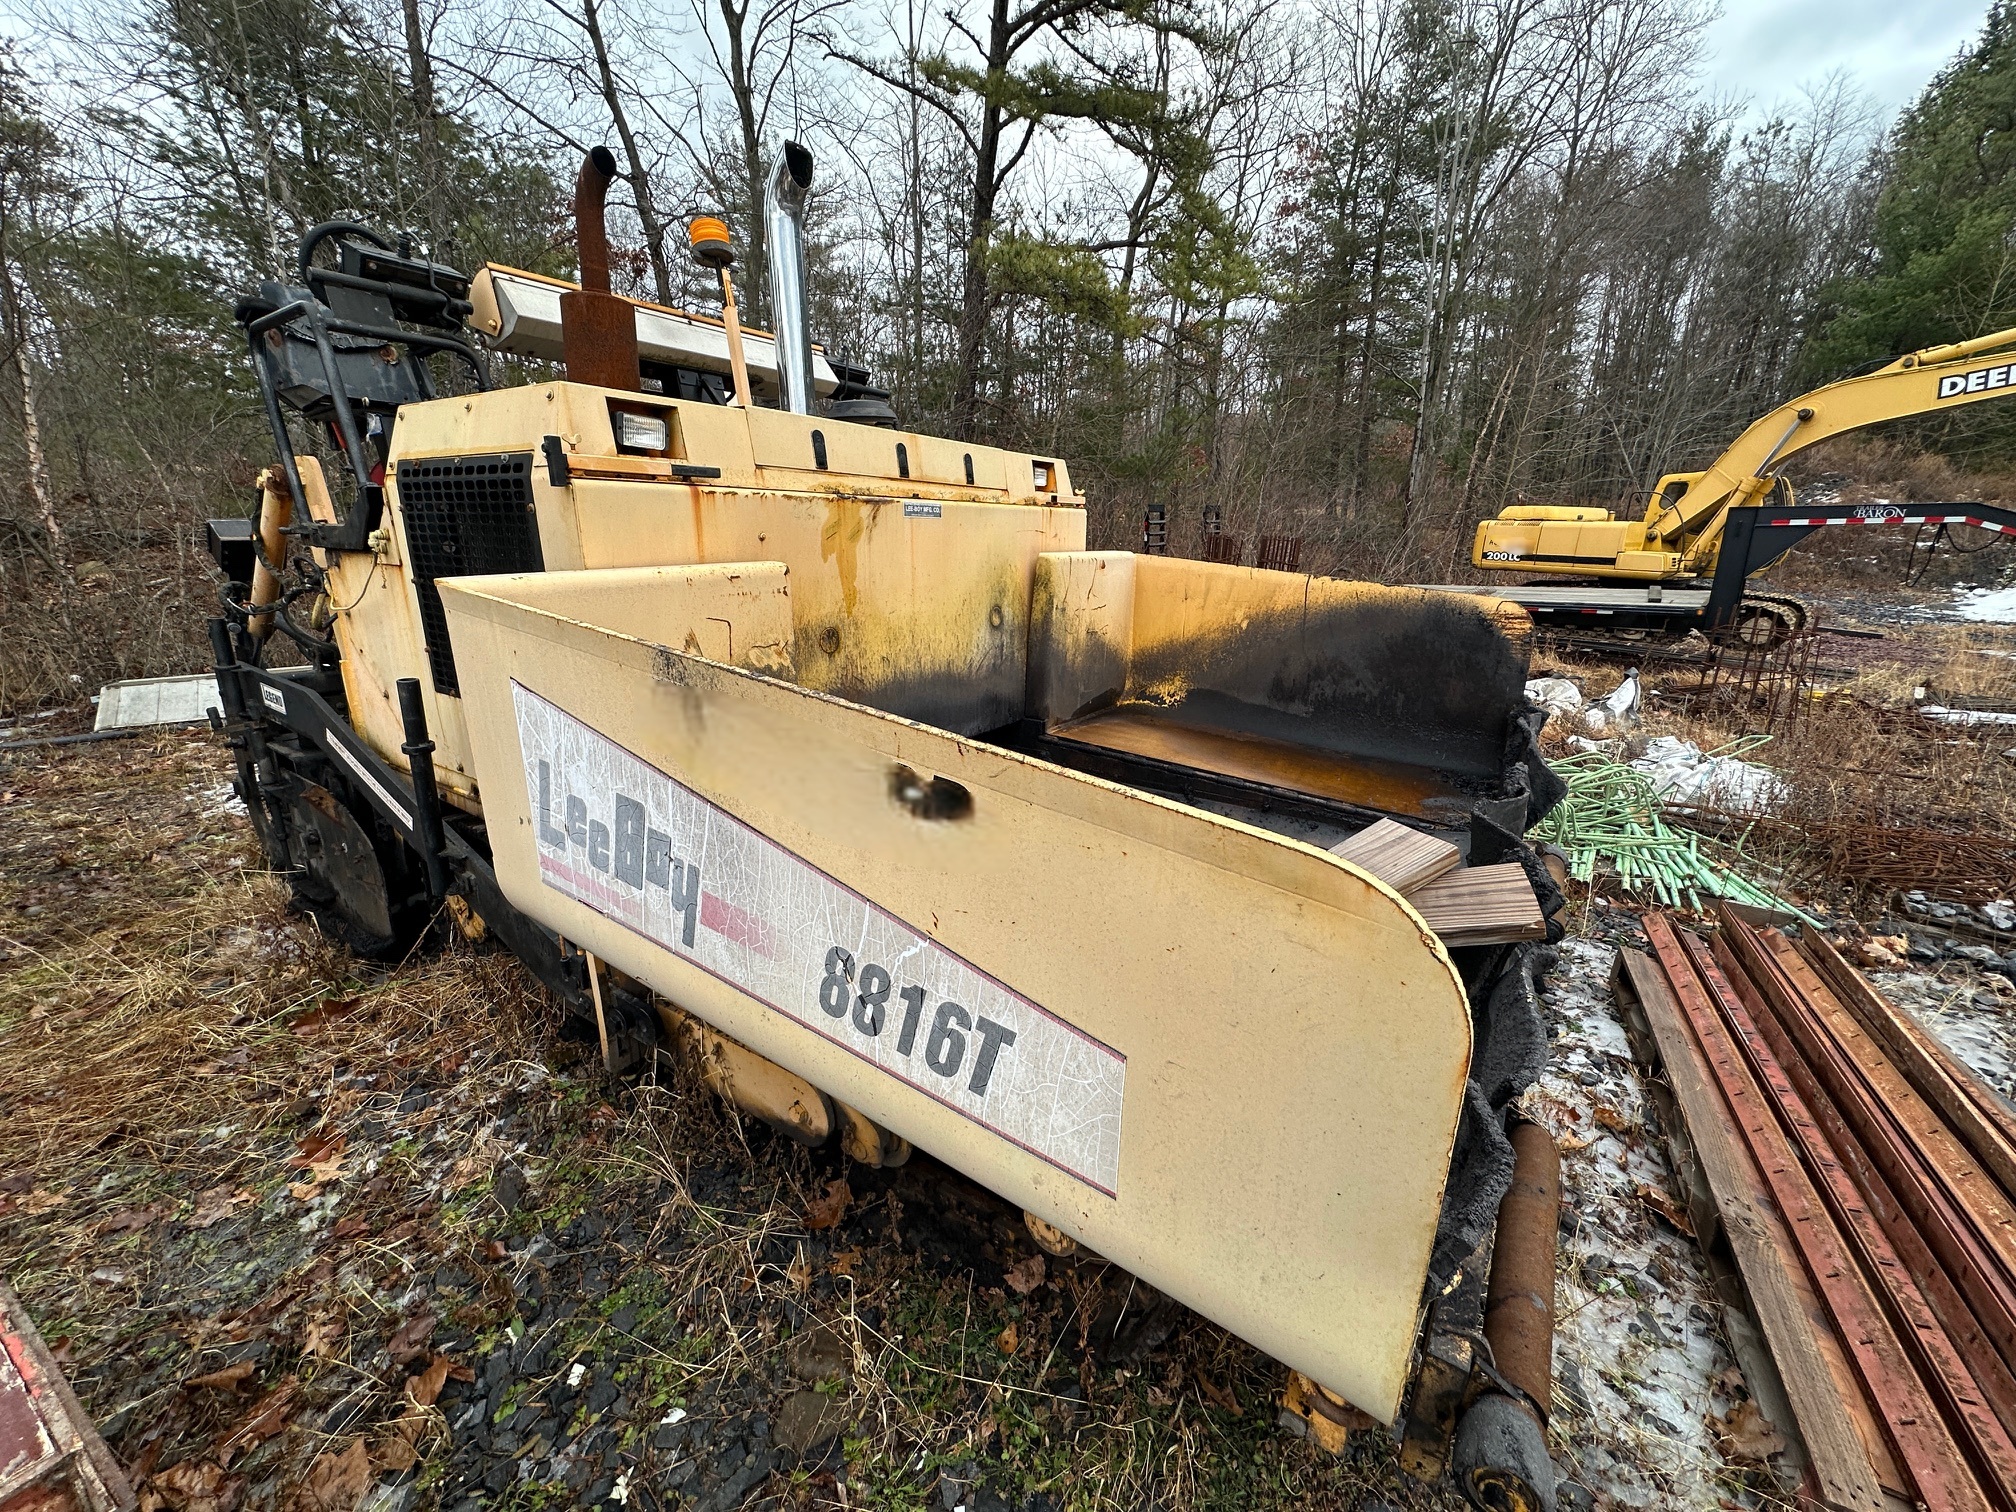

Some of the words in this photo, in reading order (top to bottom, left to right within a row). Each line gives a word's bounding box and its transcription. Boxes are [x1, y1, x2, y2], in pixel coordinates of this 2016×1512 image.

[1853, 507, 1907, 519] BARON
[263, 689, 284, 707] LEGEND
[539, 758, 700, 949] LeeBoy
[819, 946, 1017, 1097] 8816T
